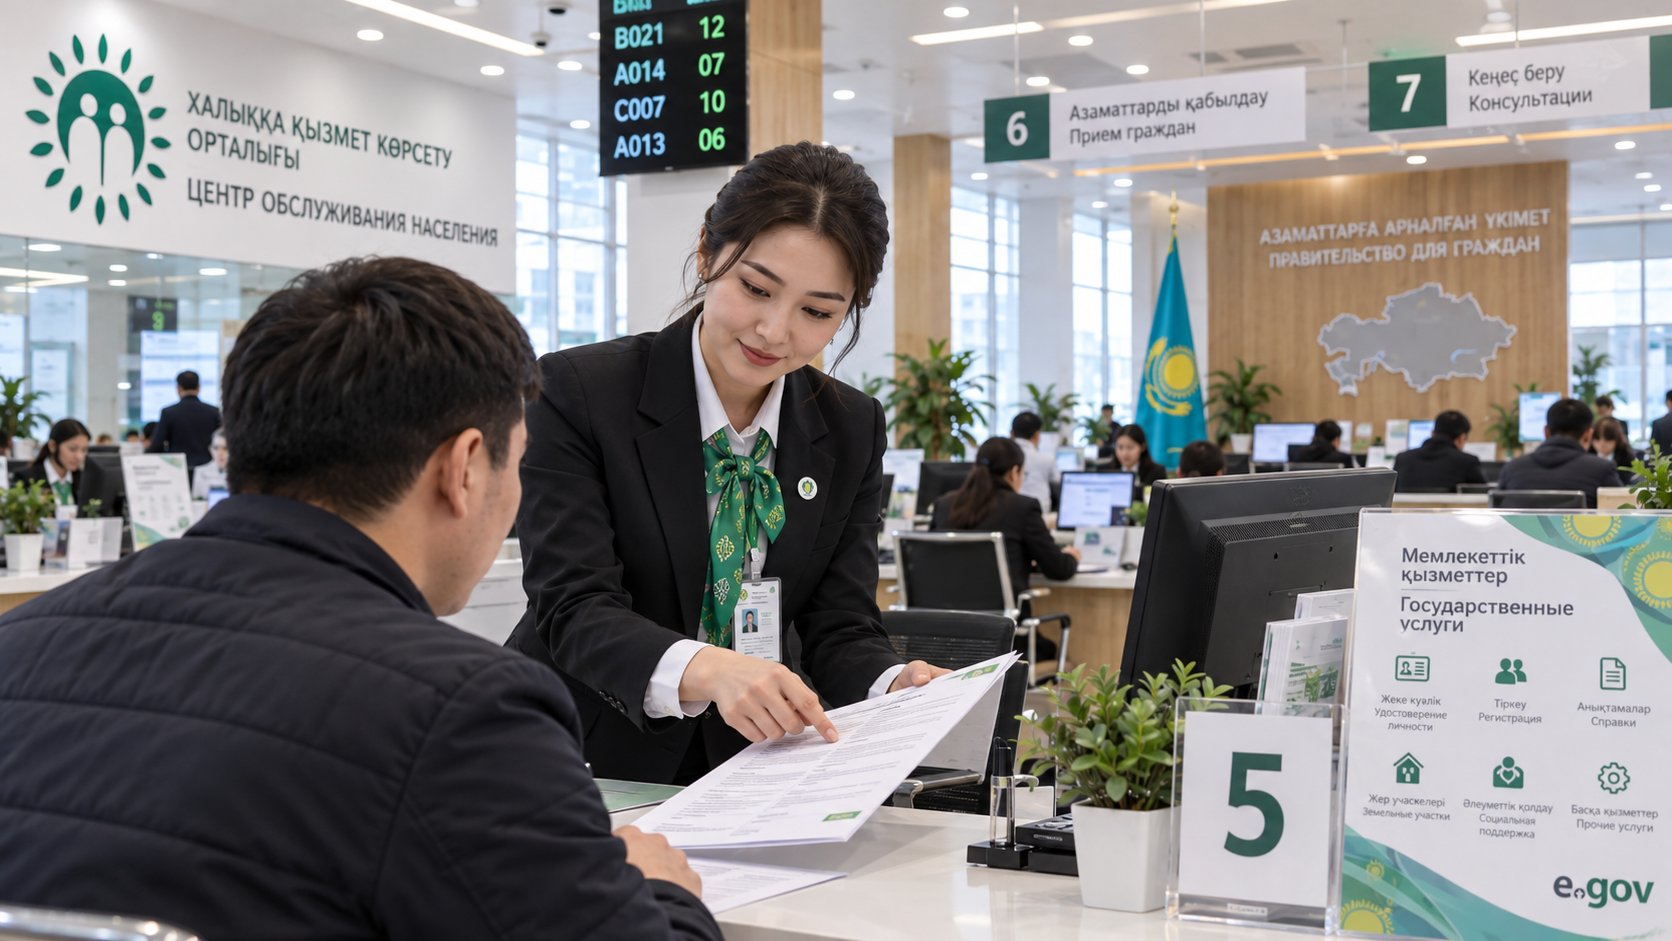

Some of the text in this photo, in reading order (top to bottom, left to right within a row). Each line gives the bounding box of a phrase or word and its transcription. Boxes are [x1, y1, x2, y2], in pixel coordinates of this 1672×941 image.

[614, 21, 663, 50] B021
[699, 14, 725, 39] 12
[613, 58, 666, 86] A014
[698, 52, 725, 77] 07
[1524, 63, 1565, 84] беру
[699, 89, 726, 114] 10
[1396, 73, 1421, 113] 7
[1469, 90, 1593, 113] Консультации
[613, 95, 666, 123] C007
[1069, 91, 1269, 121] Азаматтарды қабылдау
[187, 90, 453, 169] ХАЛЫҚҚА ҚЫЗМЕТ КӨРСЕТУ
[698, 127, 726, 151] 06
[1006, 110, 1029, 147] 6
[1069, 122, 1196, 147] Прием граждан
[187, 128, 299, 171] ОРТАЛЫҒЫ
[613, 132, 666, 159] A013
[187, 177, 498, 247] ЦЕНТР ОБСЛУЖИВАНИЯ НАСЕЛЕНИЯ
[1484, 208, 1551, 230] ҮКІМЕТ
[1269, 235, 1540, 269] ПРАВИТЕЛЬСТВО ДЛЯ ГРАЖДАН
[1401, 547, 1526, 565] Мемлекеттік
[1401, 569, 1508, 588] қызметтер
[1400, 596, 1574, 618] Государственные
[1400, 618, 1464, 636] услуги
[1381, 694, 1407, 705] Жеке
[1494, 698, 1527, 711] Тіркеу
[1577, 701, 1651, 716] Анықтамалар
[1374, 707, 1447, 720] Удостоверение
[1478, 712, 1542, 725] Регистрация
[1591, 716, 1636, 728] Справки
[1387, 722, 1433, 732] личности
[1223, 751, 1285, 858] 5
[1368, 793, 1445, 809] Жер учаскелері
[1463, 798, 1553, 815] Әлеуметтік қолдау
[1571, 804, 1659, 820] Басқа қызметтер
[1362, 807, 1451, 821] Земельные участки
[1479, 813, 1536, 826] Социальная
[1479, 828, 1535, 839] поддержка
[1576, 818, 1654, 834] Прочие услуги
